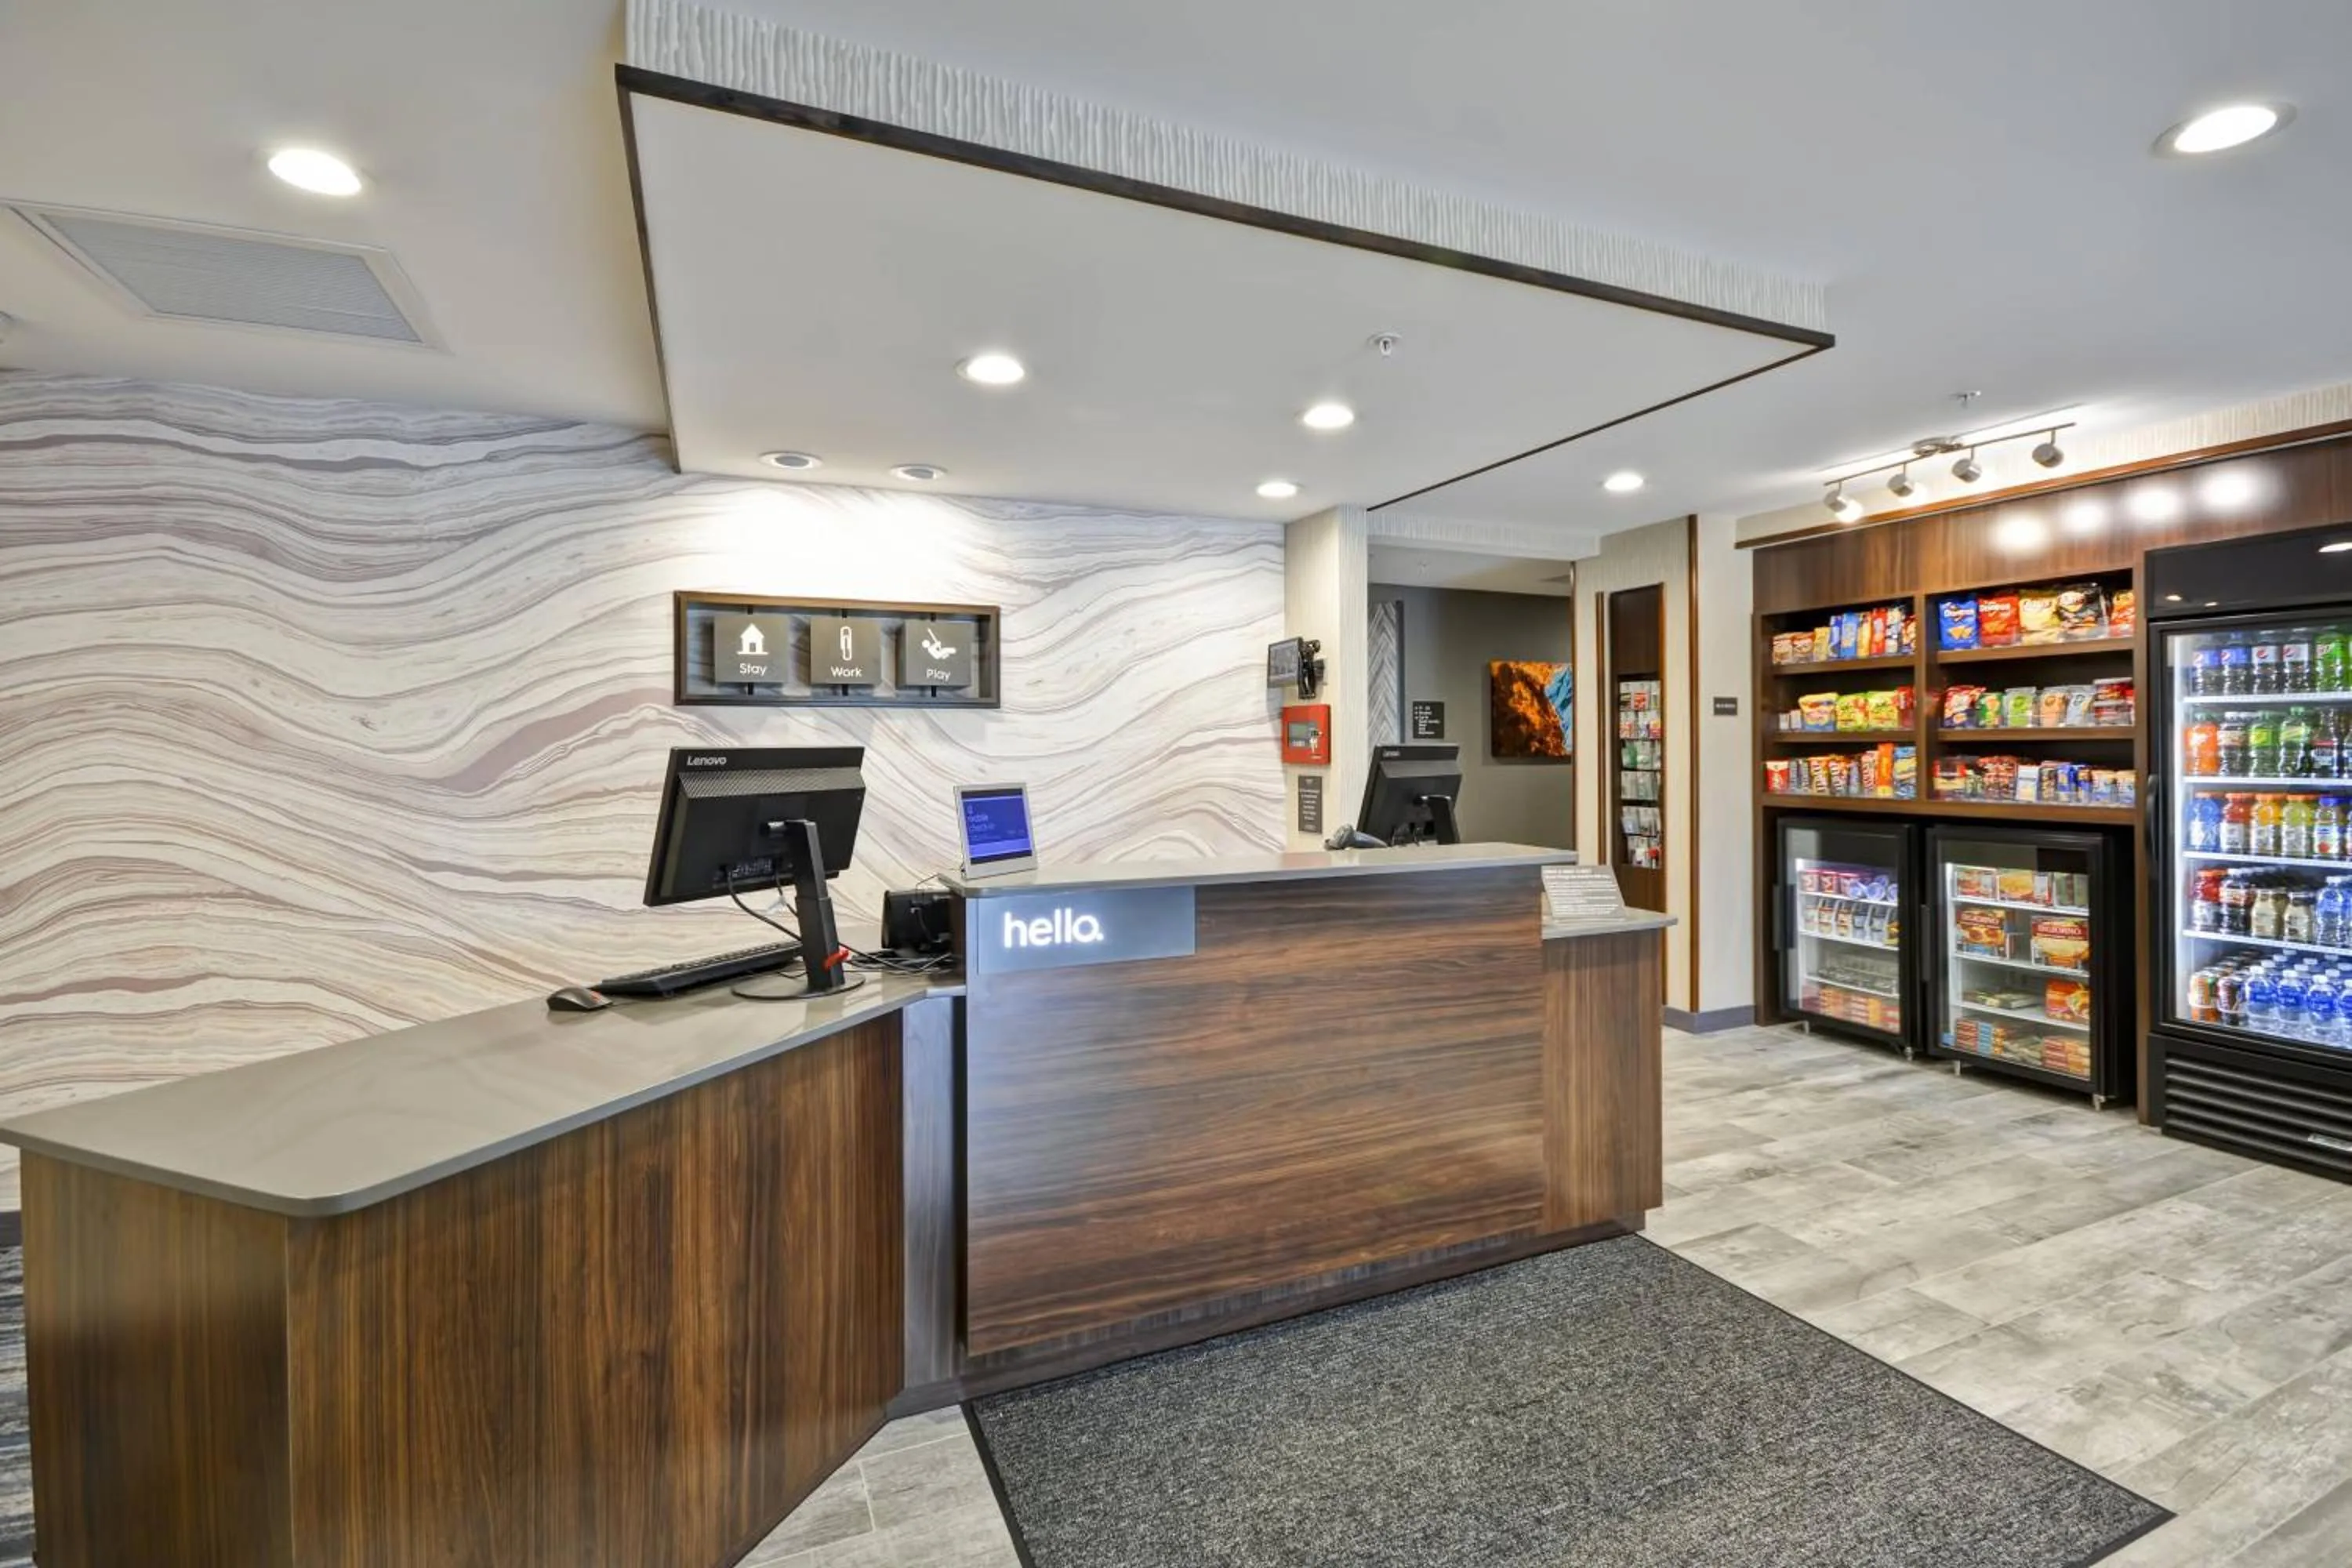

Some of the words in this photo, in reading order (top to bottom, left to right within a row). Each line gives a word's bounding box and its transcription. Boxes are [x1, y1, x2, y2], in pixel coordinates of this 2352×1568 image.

[739, 662, 768, 677] Stay
[830, 666, 862, 677] Work
[926, 668, 952, 681] Play
[686, 755, 728, 766] Lenovo
